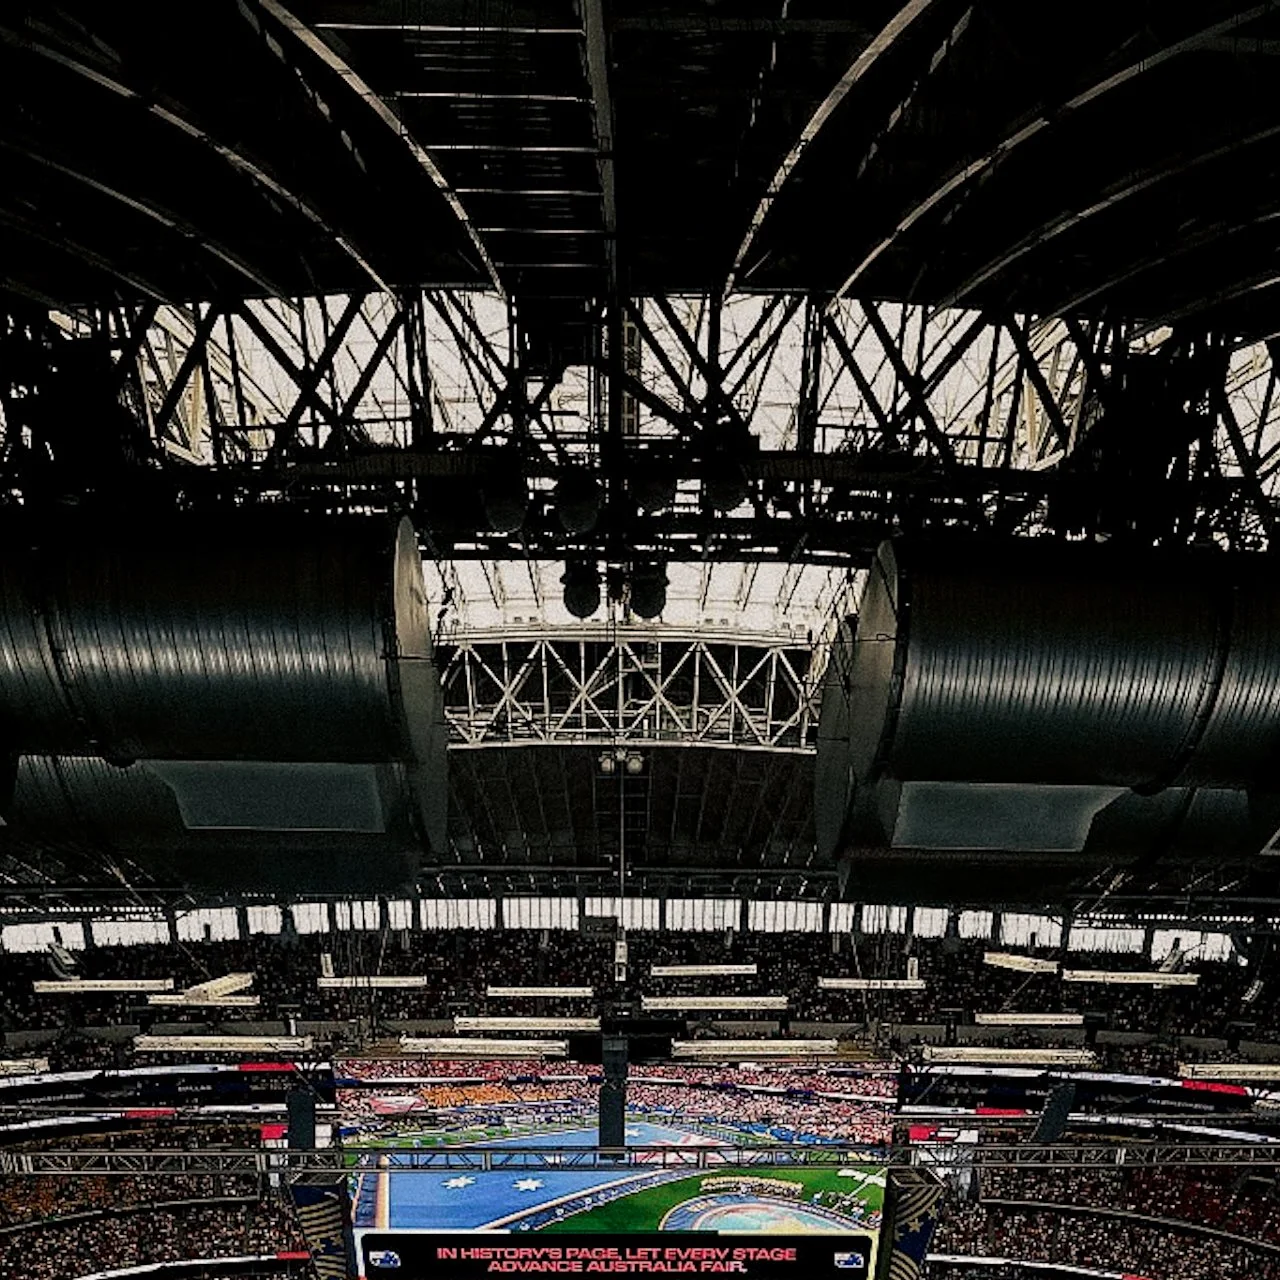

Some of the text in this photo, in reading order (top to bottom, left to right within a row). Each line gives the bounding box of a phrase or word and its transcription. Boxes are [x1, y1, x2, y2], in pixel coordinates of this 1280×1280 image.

[436, 1247, 458, 1259] IN
[461, 1247, 563, 1259] HISTORY'S
[626, 1248, 661, 1260] LET
[664, 1248, 729, 1260] EVERY
[732, 1248, 797, 1260] STAGE
[487, 1261, 583, 1272] ADVANCE
[586, 1261, 697, 1272] AUSTRALIA
